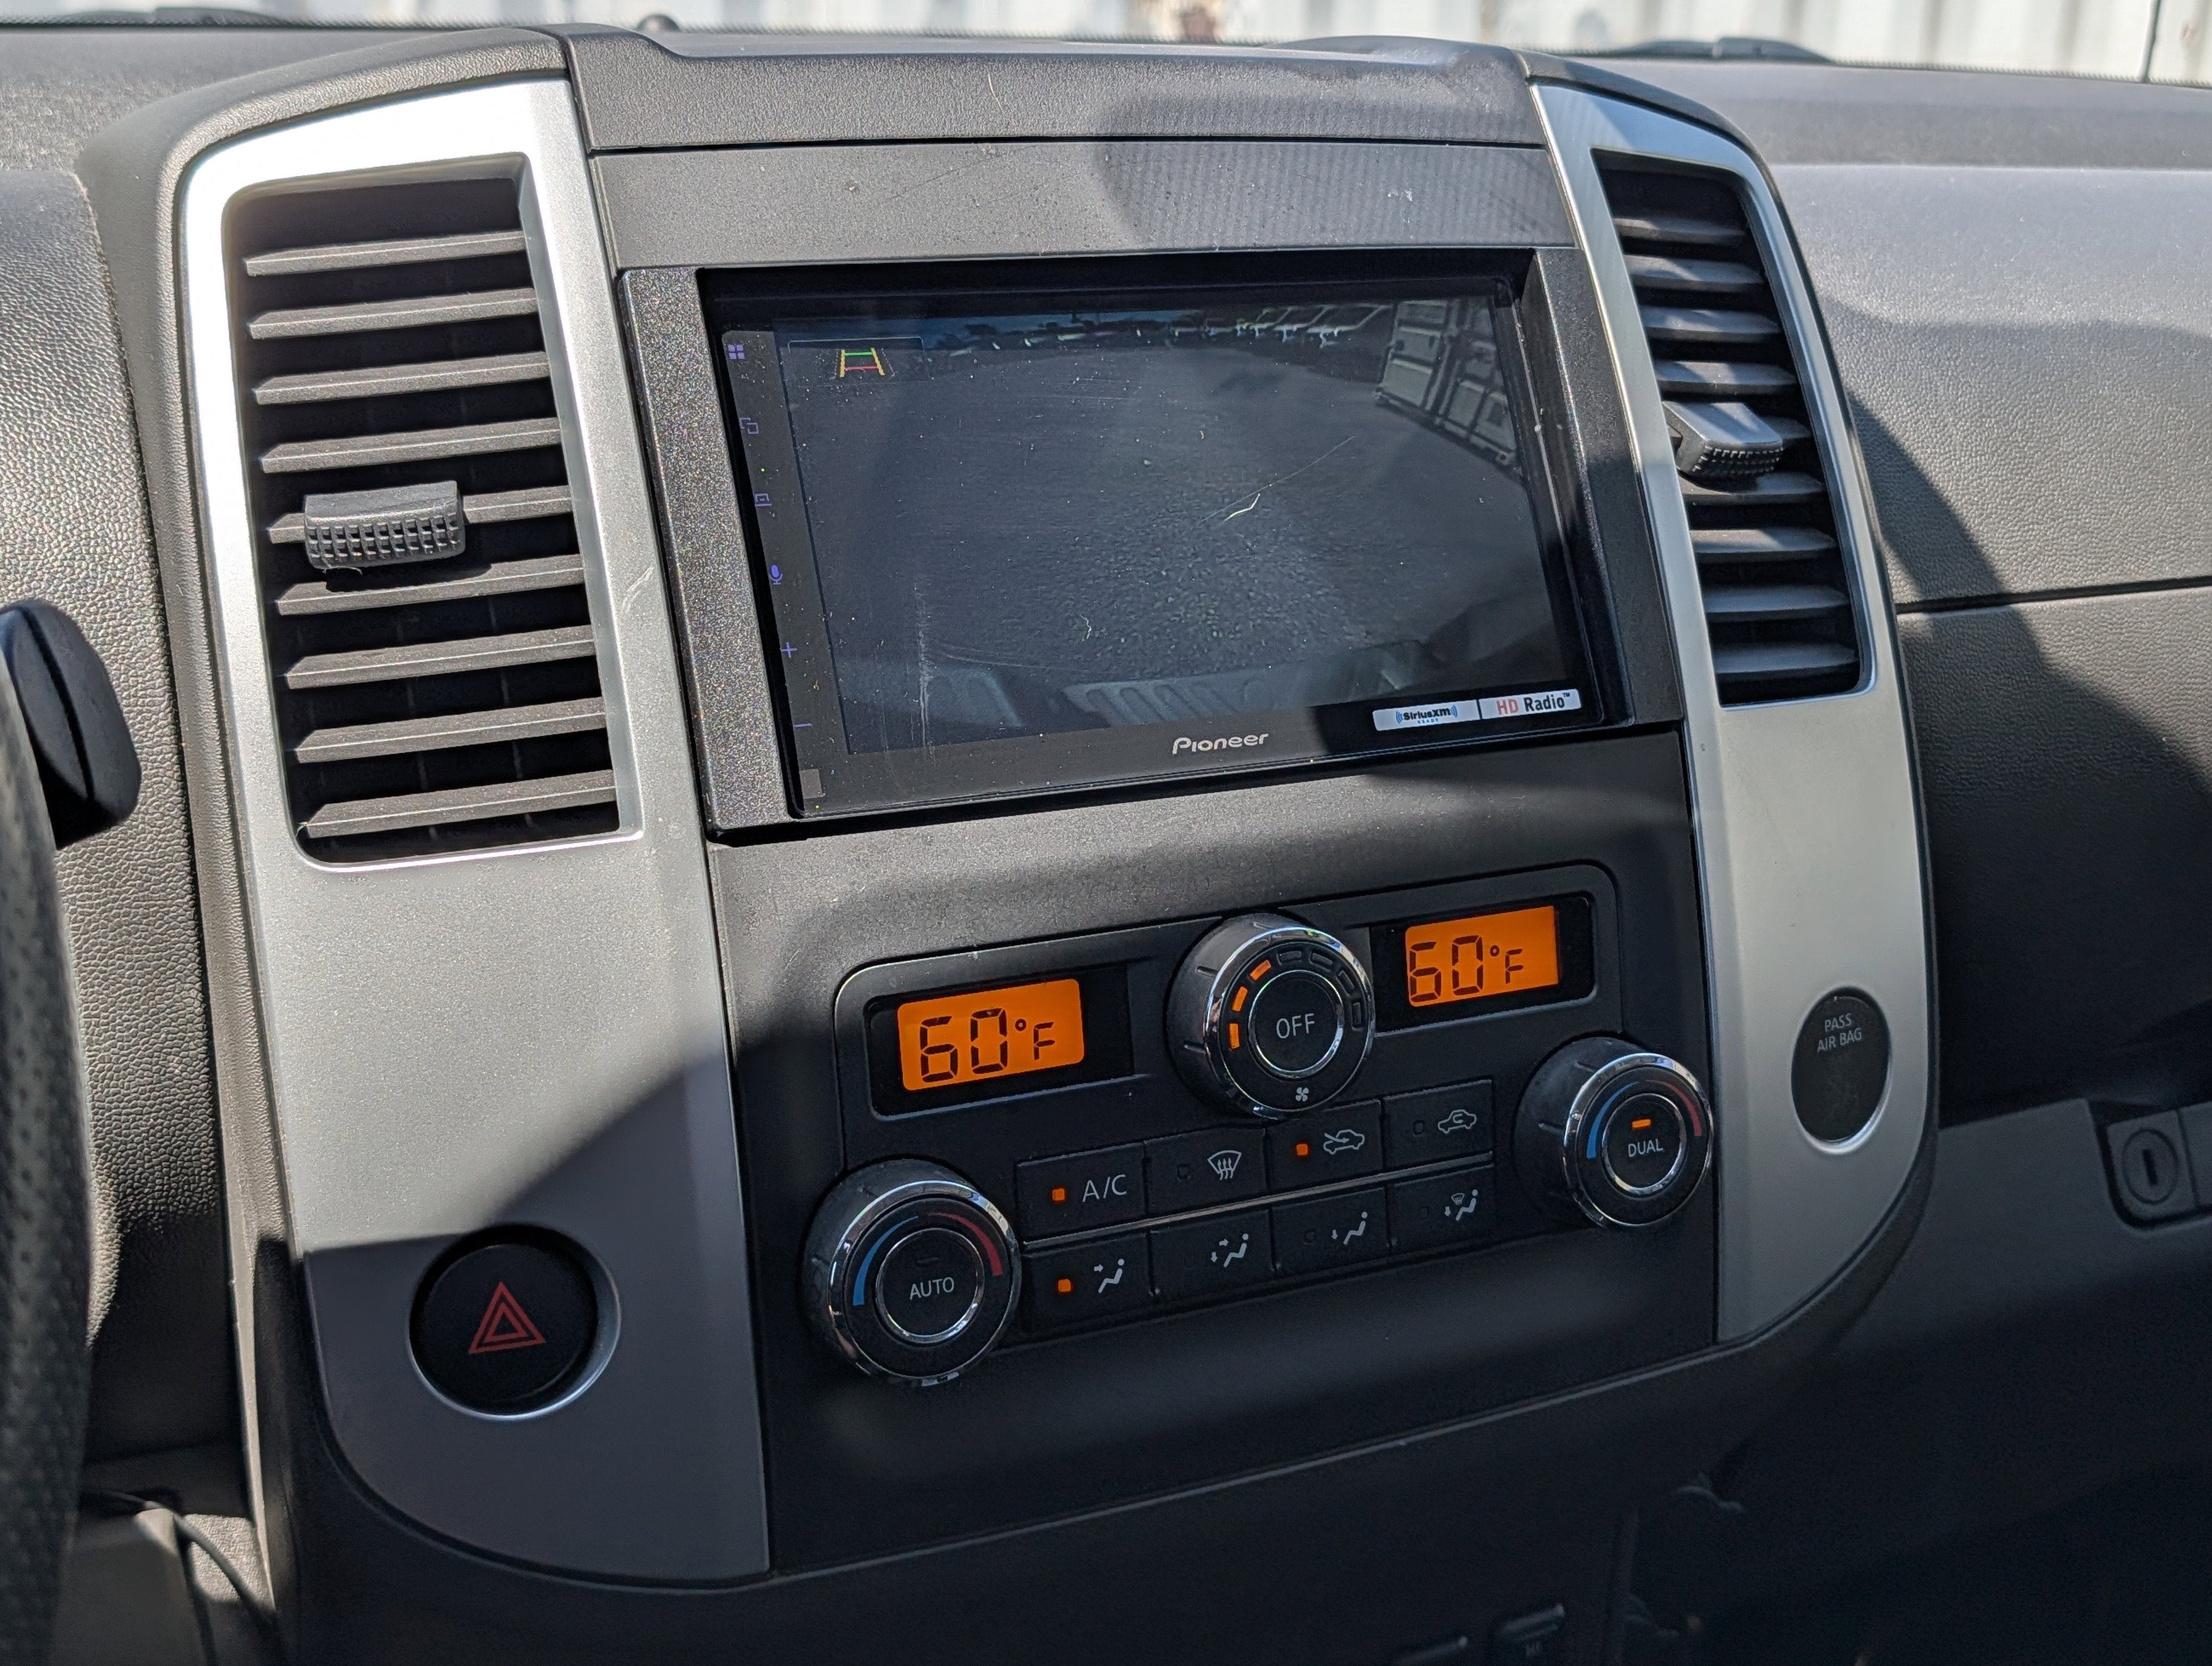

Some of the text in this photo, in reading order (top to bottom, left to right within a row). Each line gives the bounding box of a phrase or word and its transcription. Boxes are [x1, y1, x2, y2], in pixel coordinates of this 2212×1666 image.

[1496, 699, 1519, 715] HD
[1172, 733, 1269, 754] Pioneer
[1276, 1013, 1316, 1039] OFF
[1824, 1013, 1853, 1033] PASS
[1816, 1027, 1863, 1054] AIR BAG
[1628, 1138, 1664, 1158] DUAL
[1082, 1174, 1128, 1203] A/C
[909, 1276, 955, 1301] AUTO
